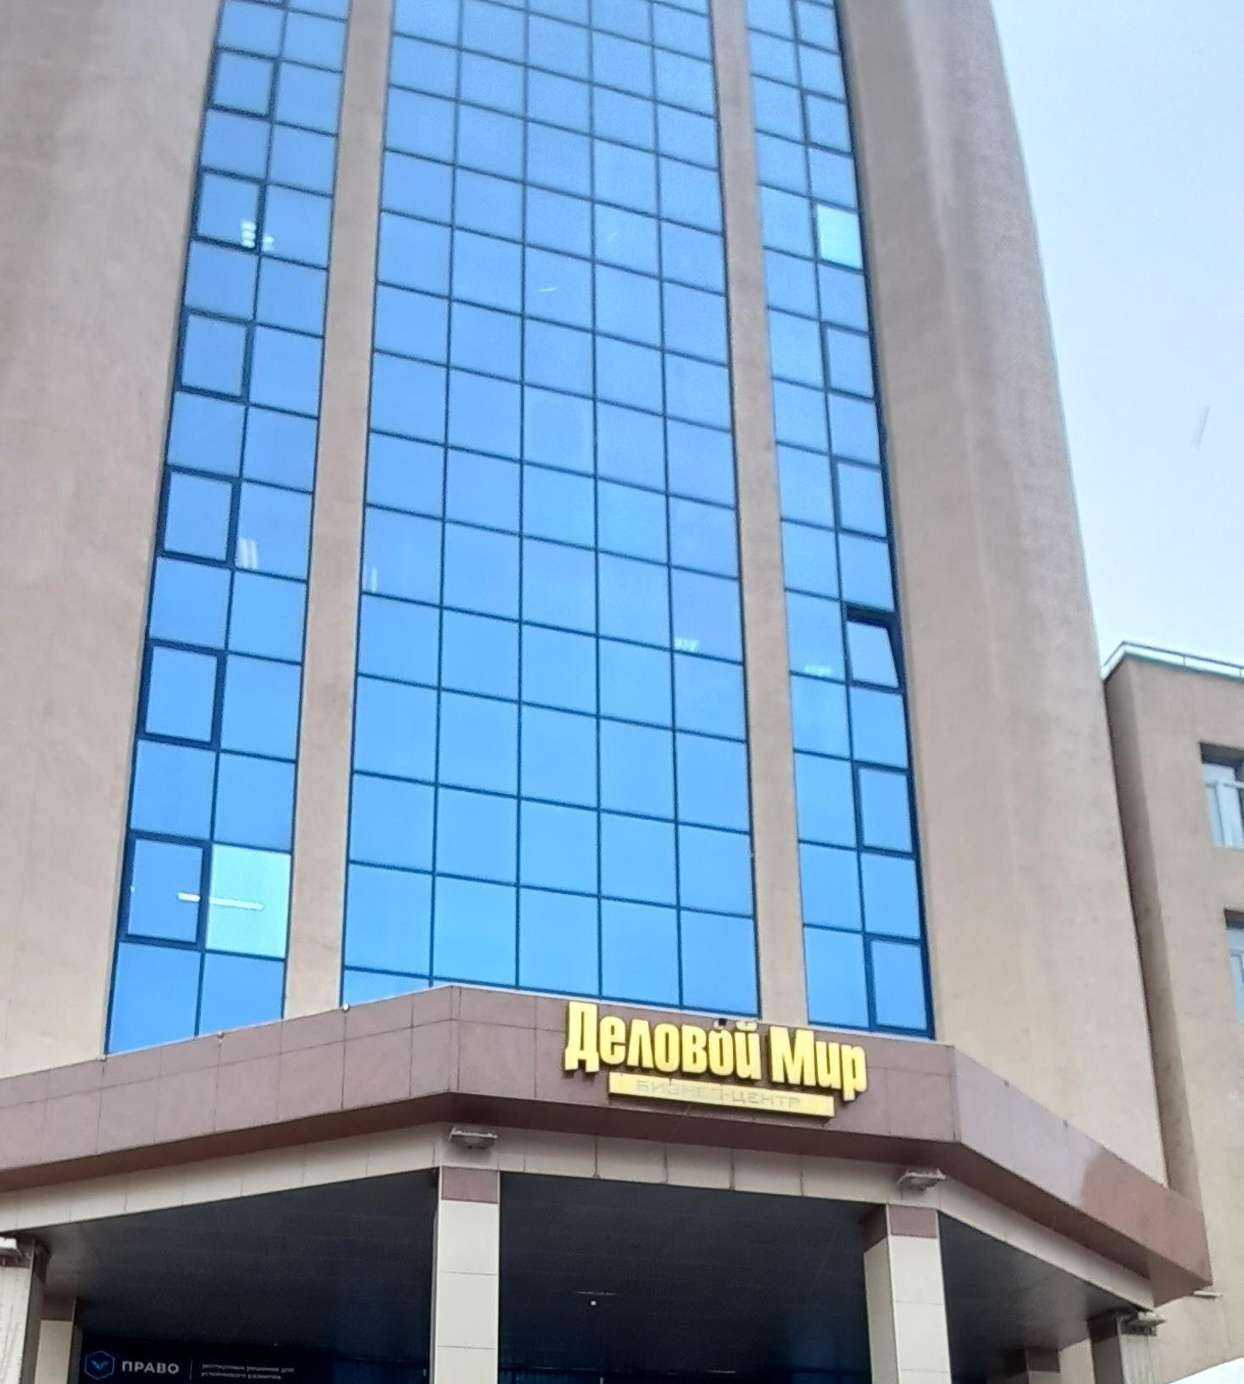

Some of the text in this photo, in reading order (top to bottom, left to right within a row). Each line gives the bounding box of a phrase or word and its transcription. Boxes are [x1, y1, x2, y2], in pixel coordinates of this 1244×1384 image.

[564, 1000, 867, 1102] Деловой Мир
[122, 1361, 180, 1375] ПРАВО
